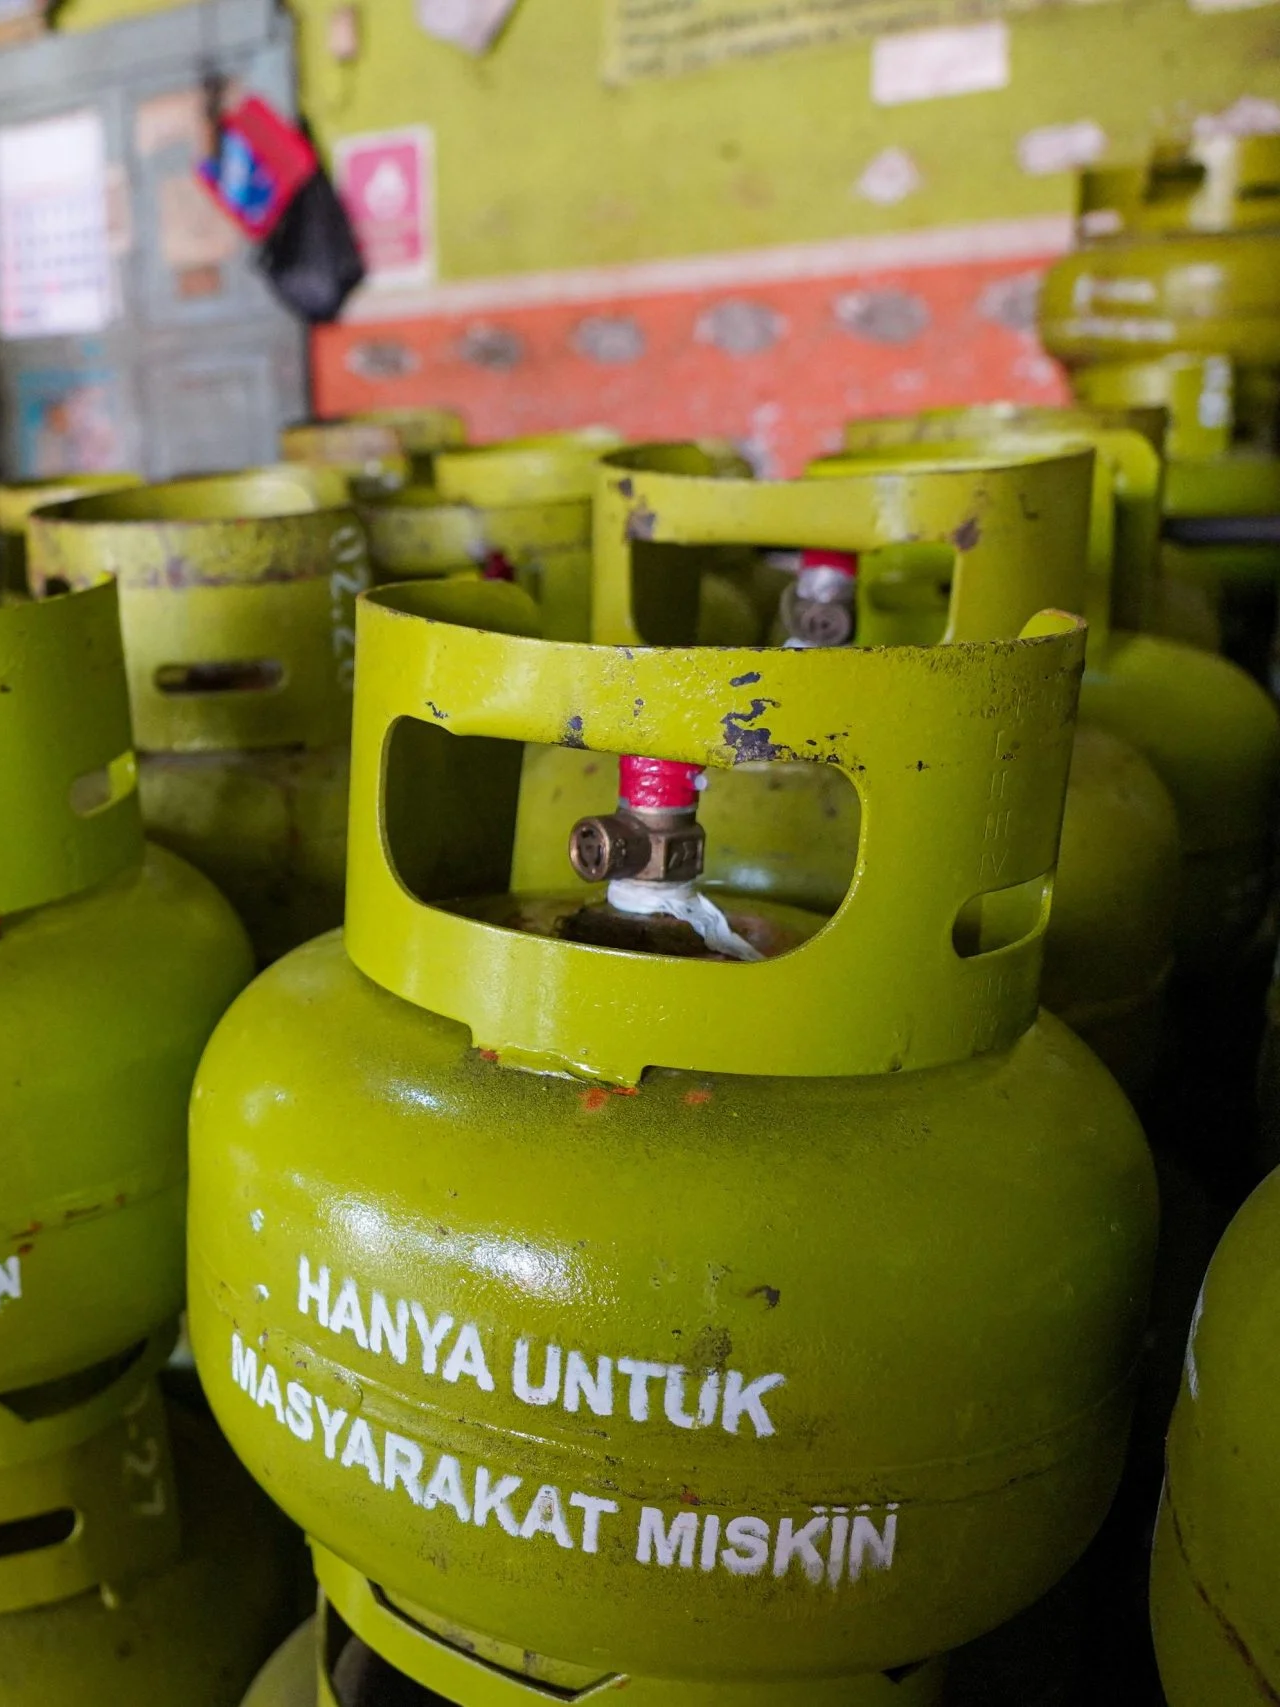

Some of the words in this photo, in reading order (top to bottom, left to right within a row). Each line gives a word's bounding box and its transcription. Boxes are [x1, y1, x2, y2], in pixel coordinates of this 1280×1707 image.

[297, 1255, 494, 1392] HANYA
[512, 1337, 786, 1437] UNTUK
[231, 1333, 619, 1553] MASYARAKAT
[635, 1503, 899, 1586] MISKIN
